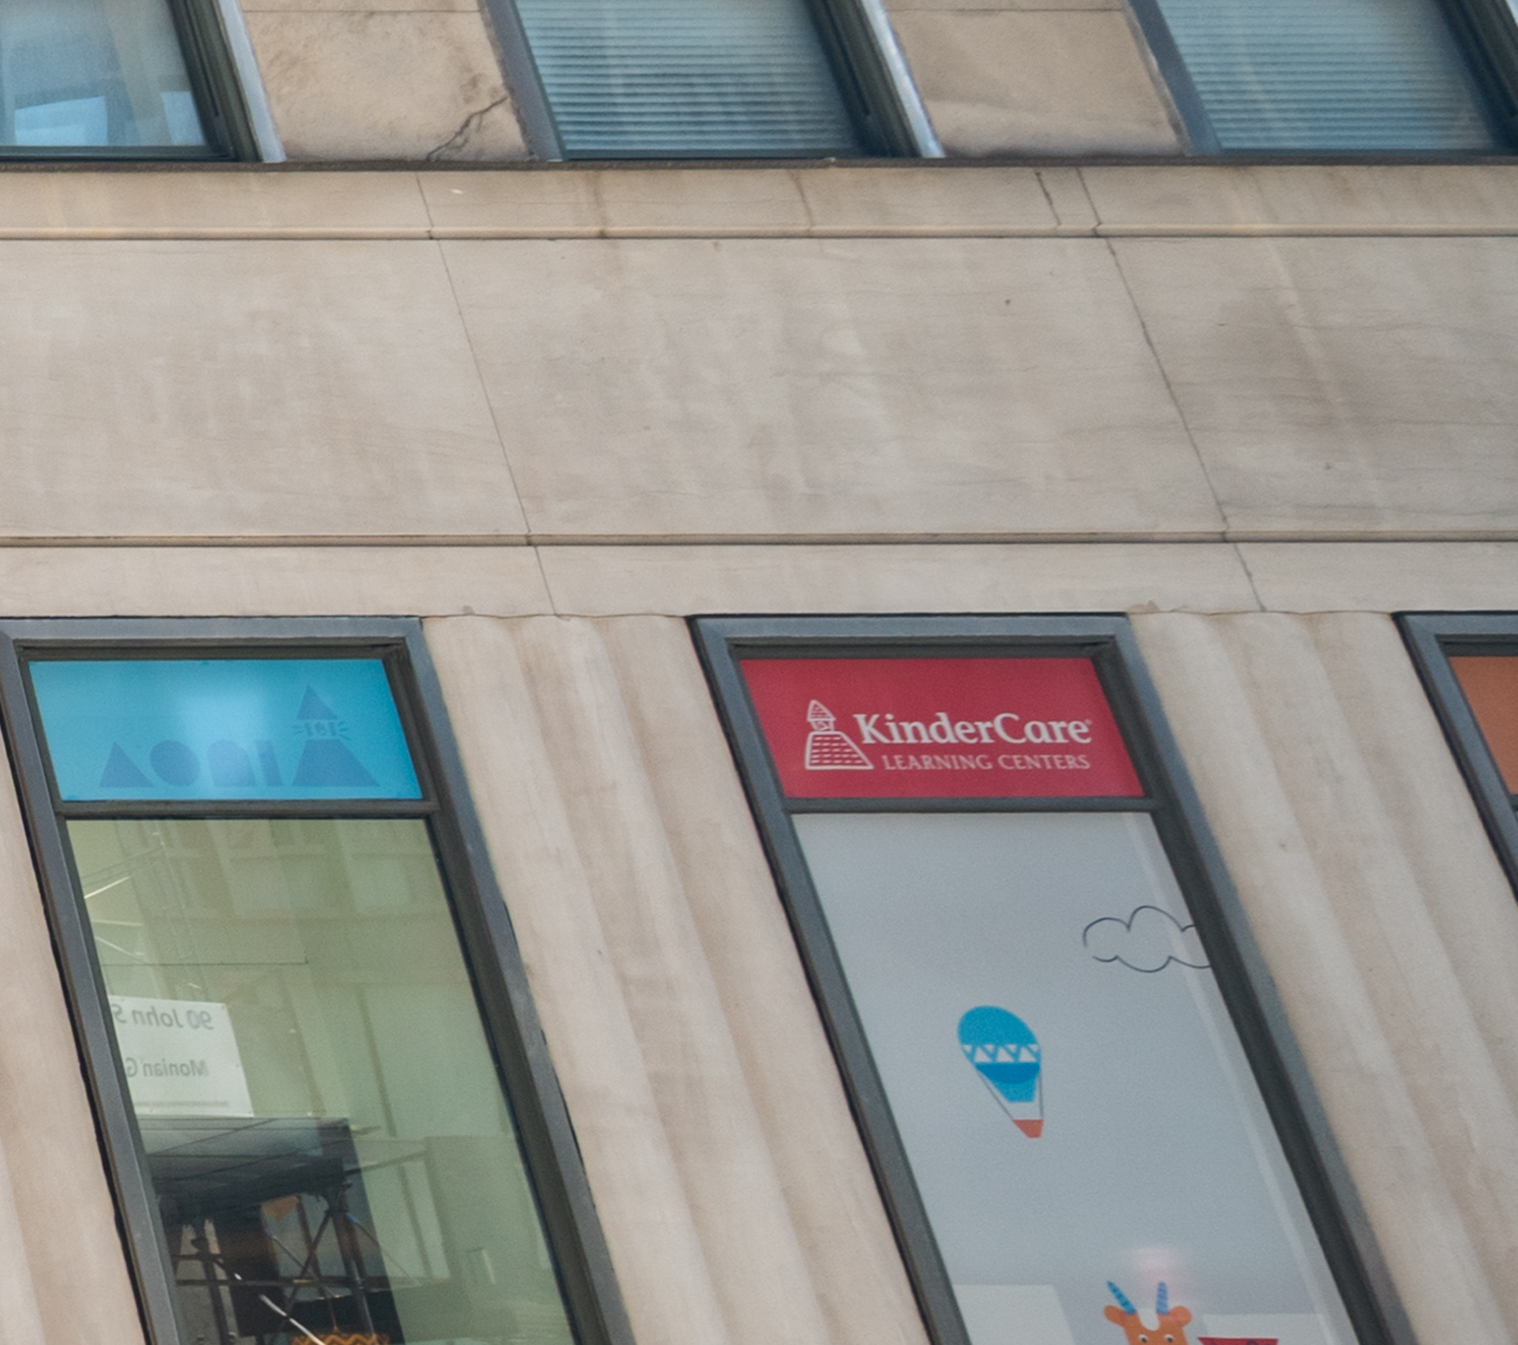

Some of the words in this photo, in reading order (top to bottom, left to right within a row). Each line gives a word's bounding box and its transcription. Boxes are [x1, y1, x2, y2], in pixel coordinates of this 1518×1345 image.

[853, 712, 1092, 744] KinderCare
[882, 755, 992, 770] LEARNING
[998, 754, 1091, 770] CENTERS
